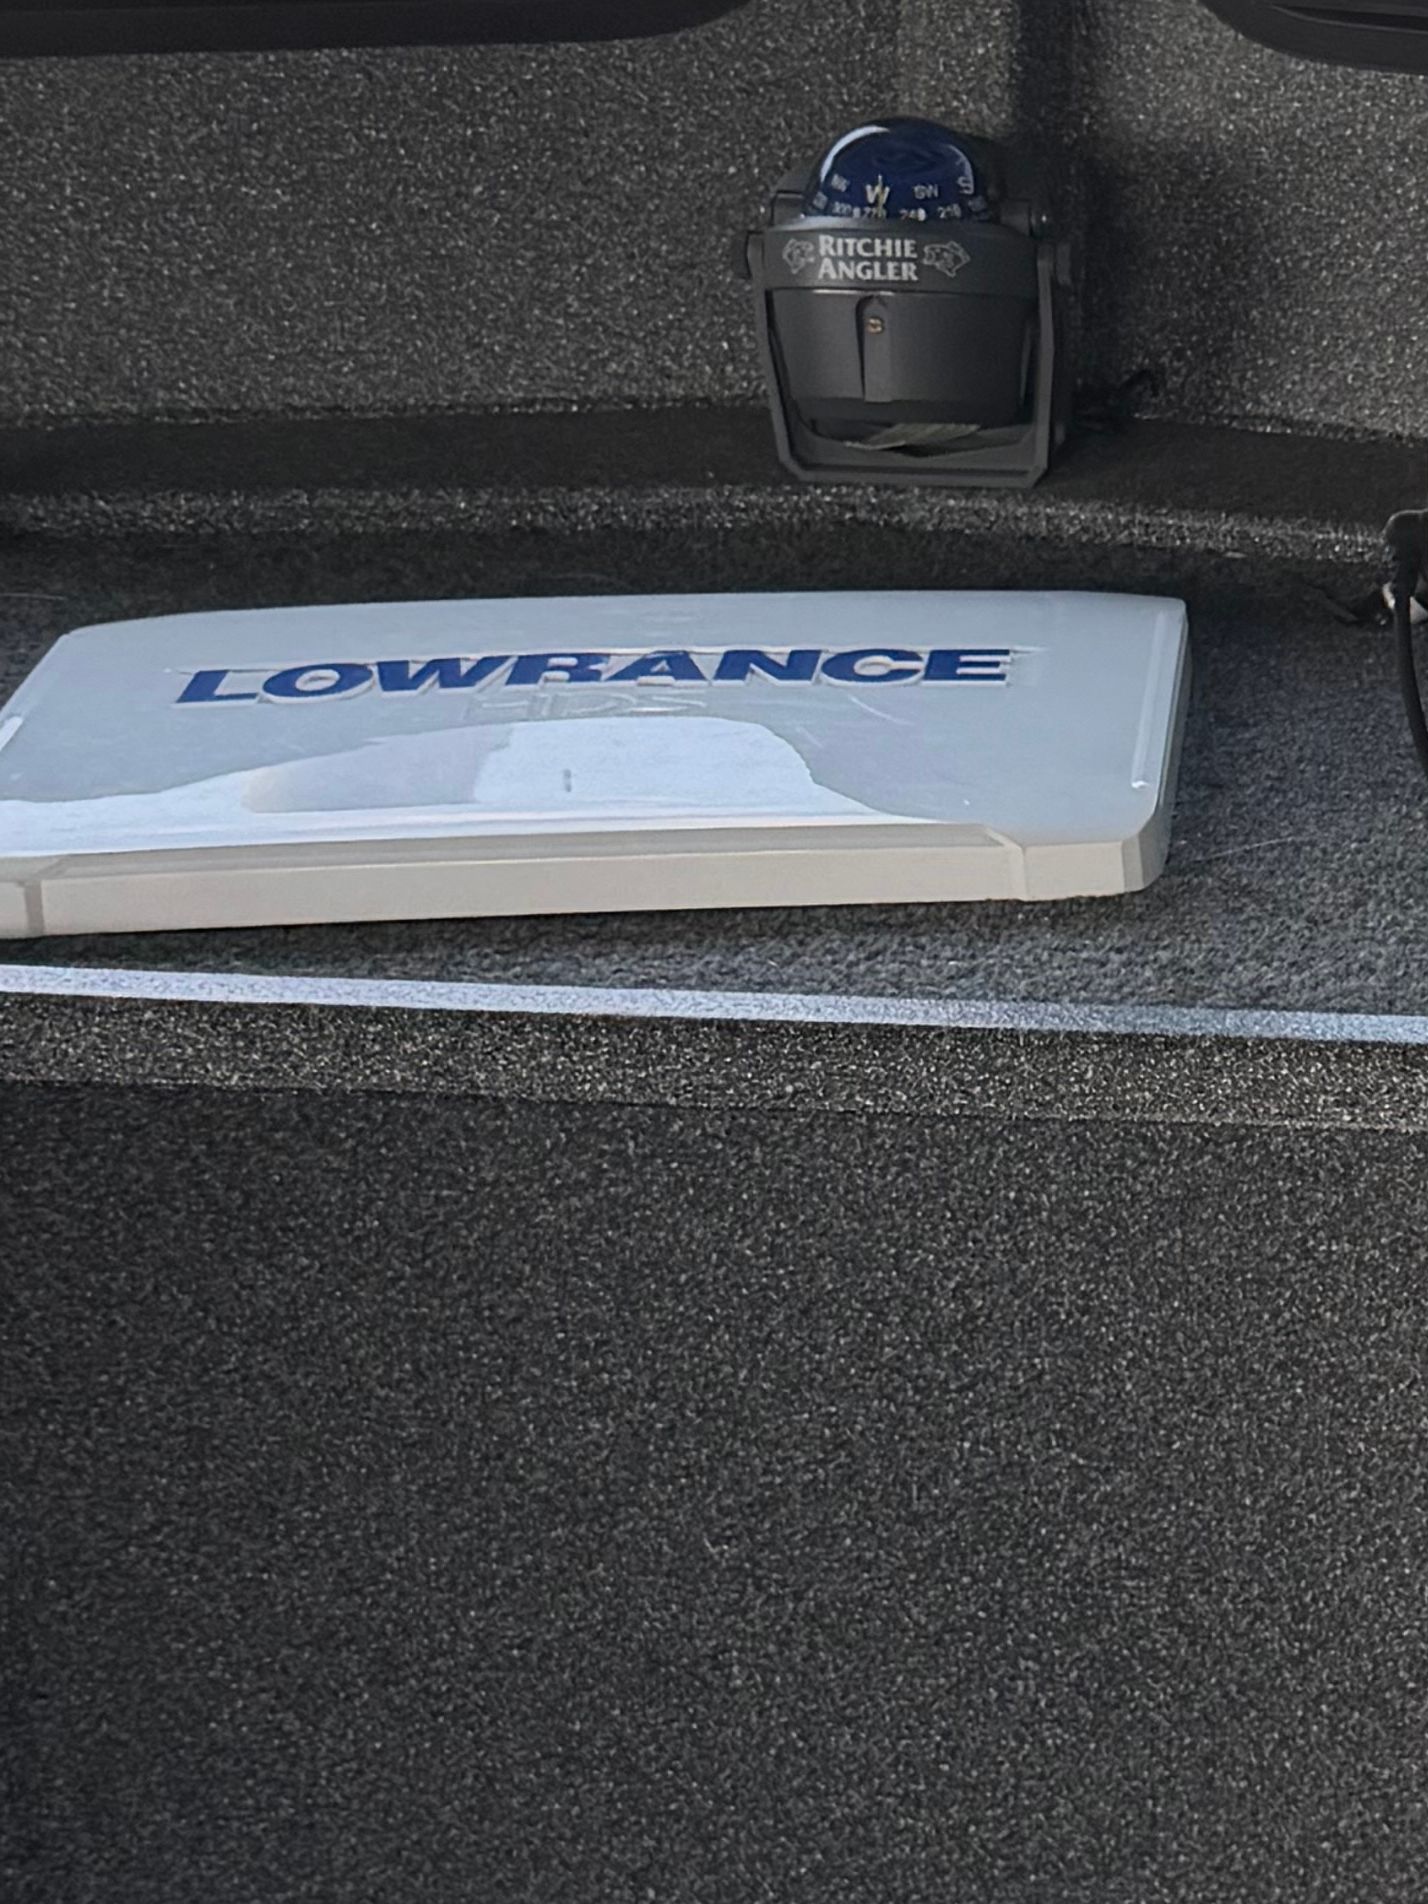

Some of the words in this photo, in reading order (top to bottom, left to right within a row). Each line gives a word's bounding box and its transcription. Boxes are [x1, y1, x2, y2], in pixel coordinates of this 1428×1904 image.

[818, 234, 918, 259] RITCHIE
[818, 258, 918, 281] ANGLER
[175, 647, 1012, 705] LOWRANCE
